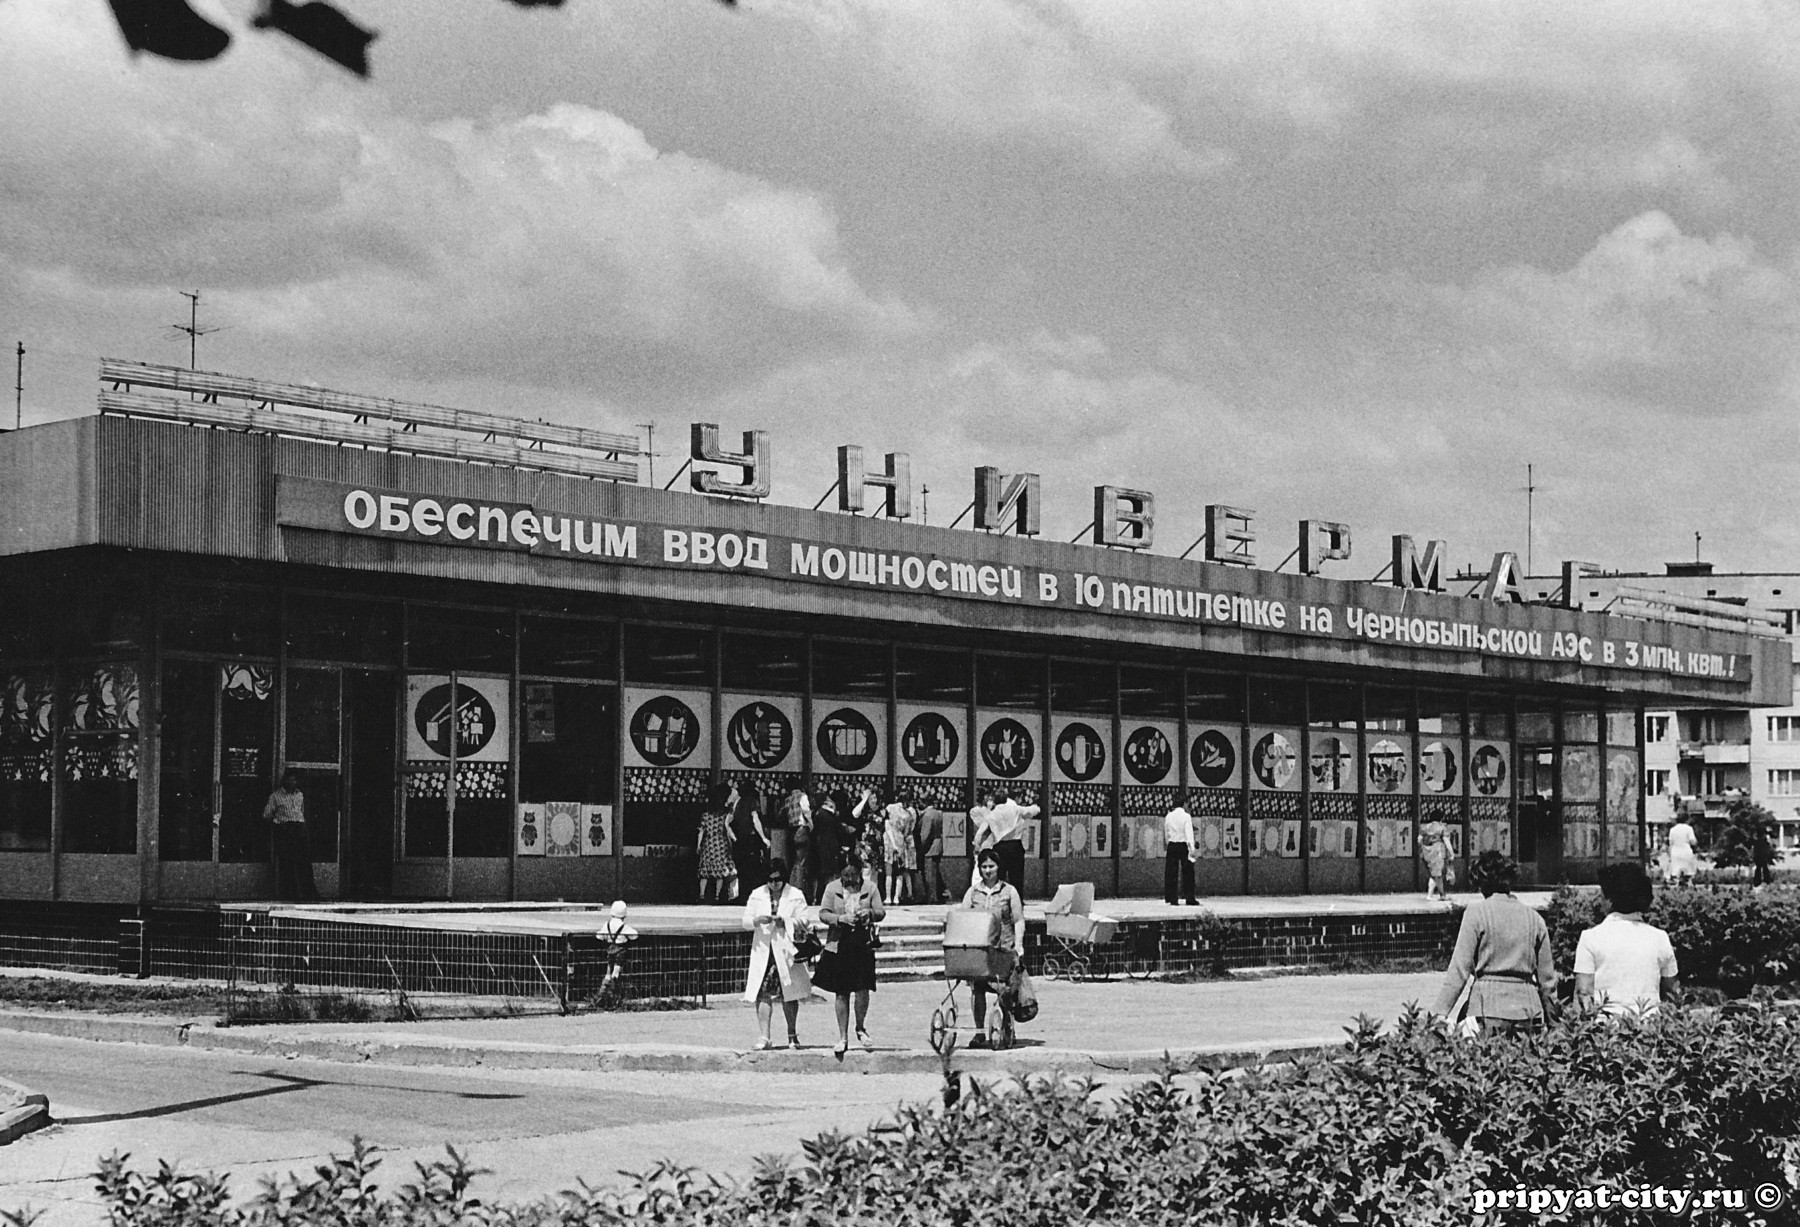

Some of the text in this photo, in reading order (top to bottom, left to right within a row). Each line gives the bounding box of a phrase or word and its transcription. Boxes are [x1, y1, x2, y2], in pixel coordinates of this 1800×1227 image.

[690, 423, 1601, 609] УНИВЕРМАГ
[1074, 573, 1105, 607] 10
[1551, 631, 1593, 661] АЭС
[1625, 640, 1639, 667] 3
